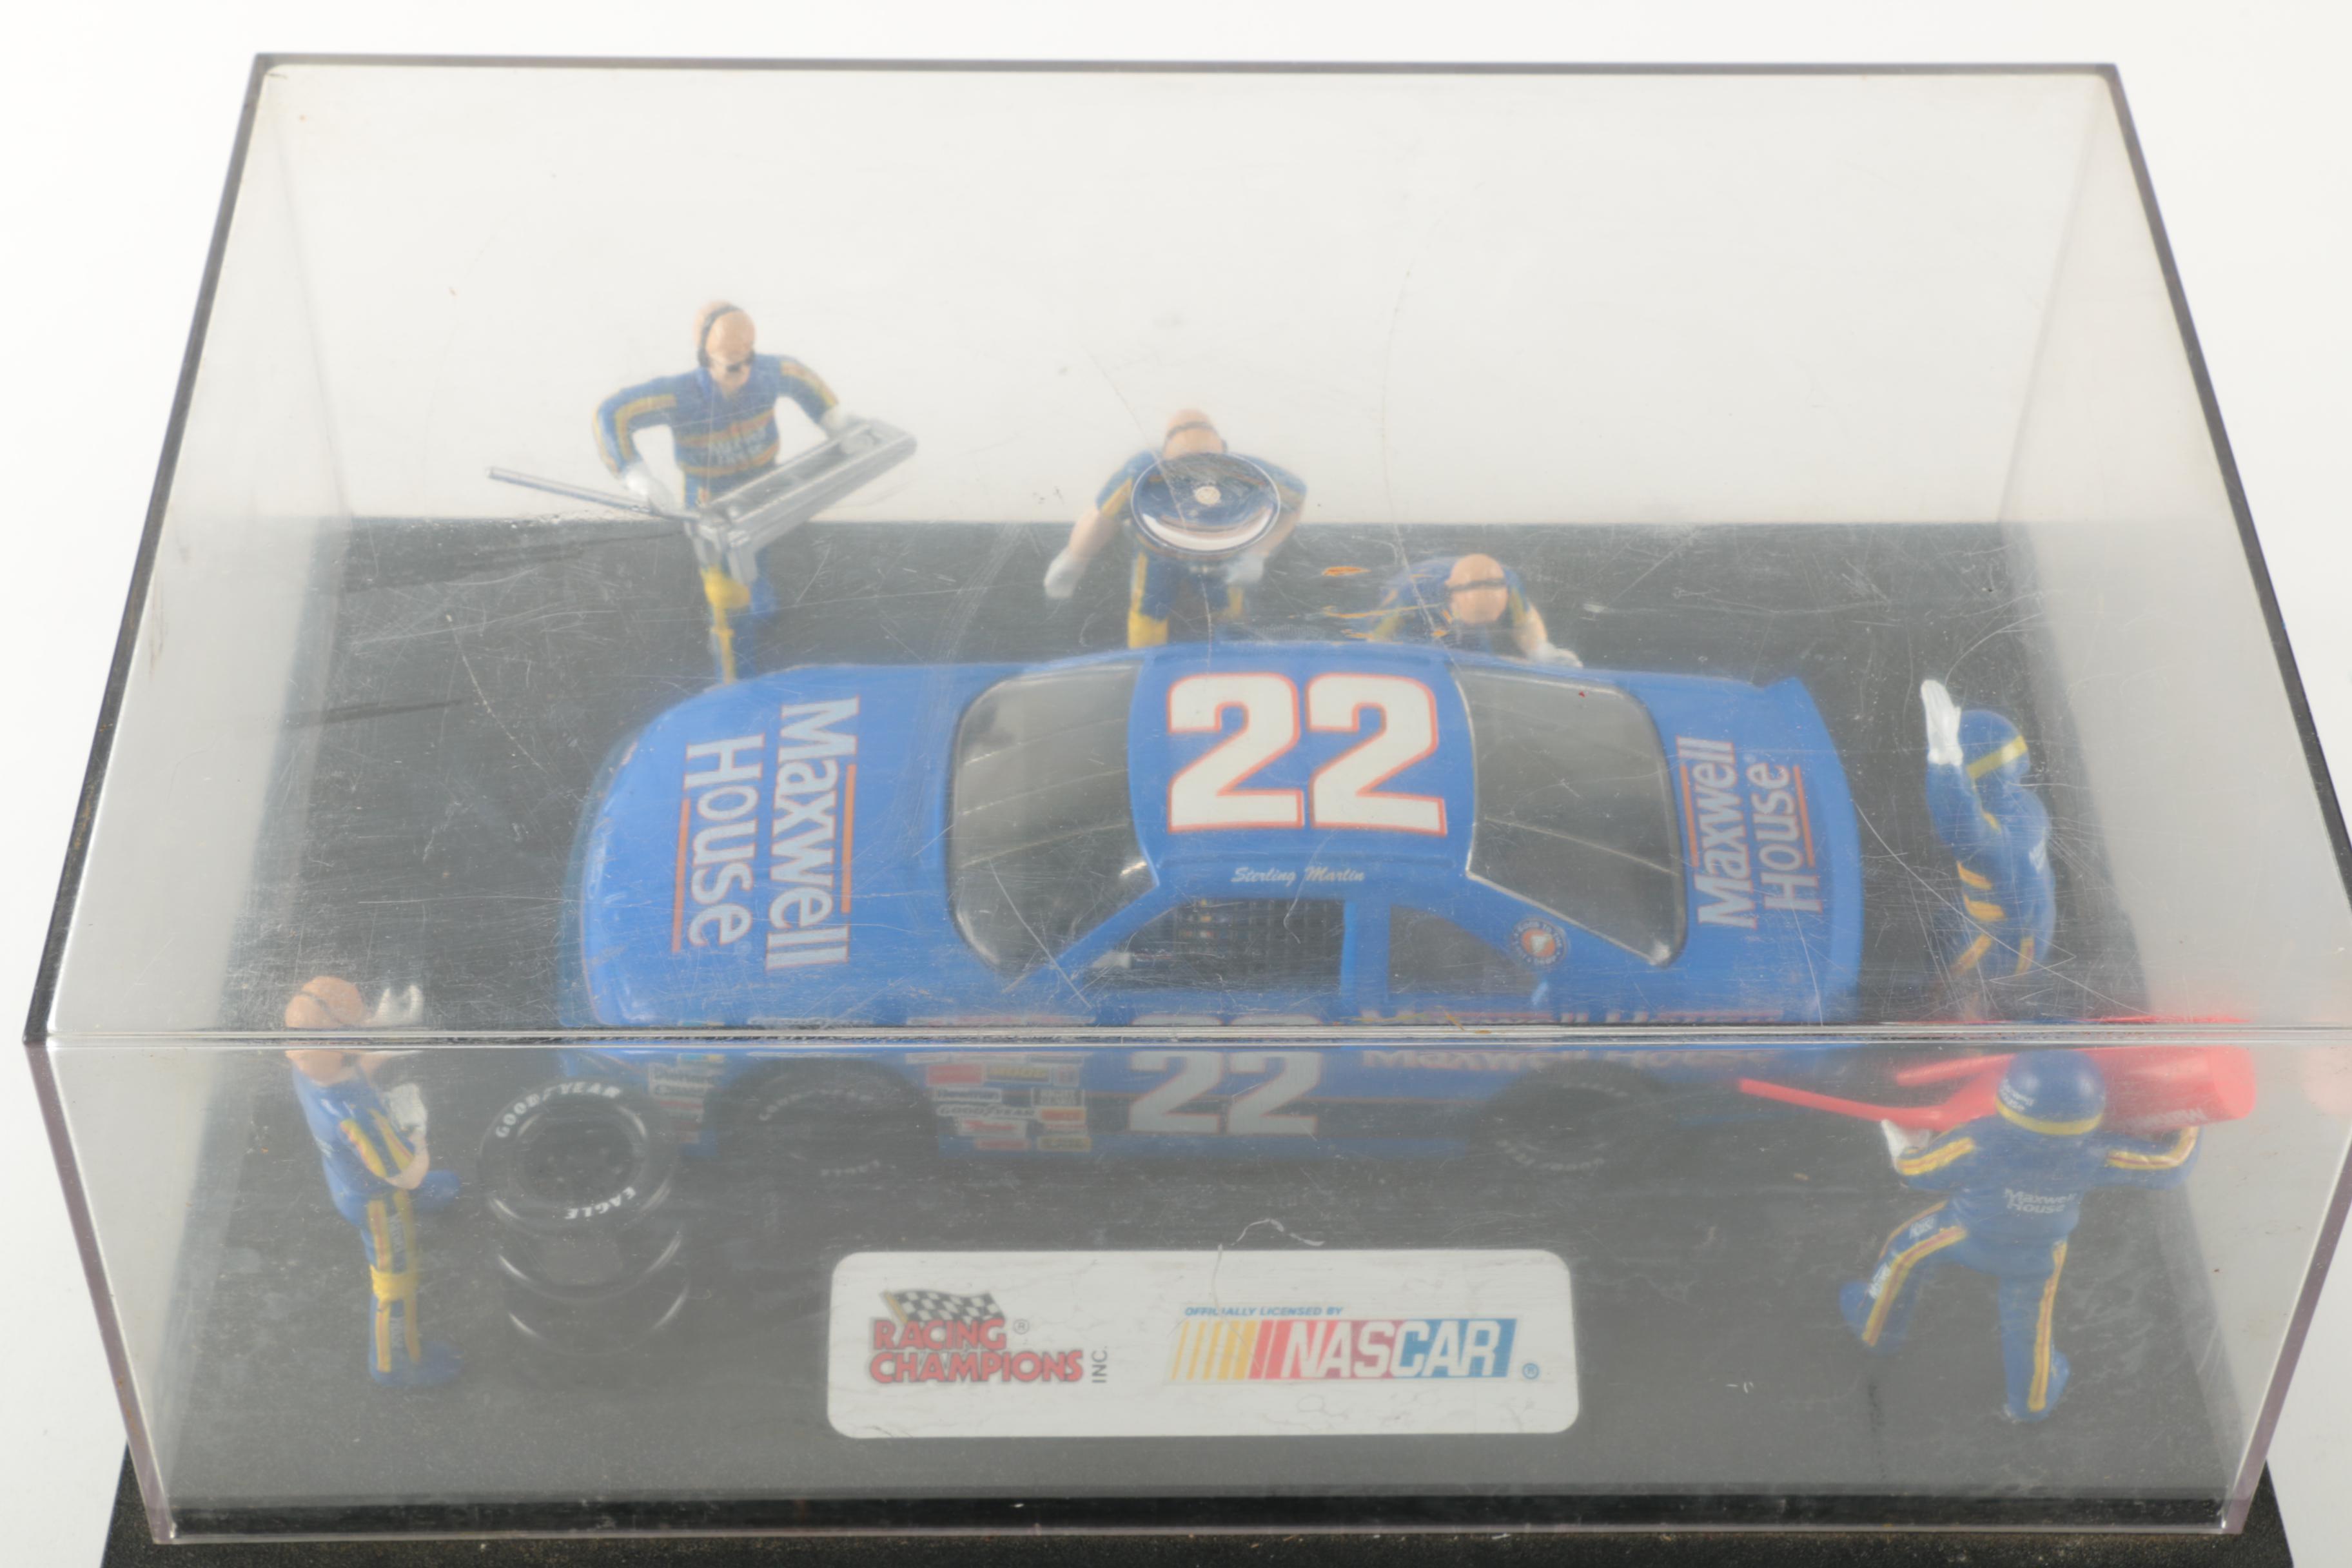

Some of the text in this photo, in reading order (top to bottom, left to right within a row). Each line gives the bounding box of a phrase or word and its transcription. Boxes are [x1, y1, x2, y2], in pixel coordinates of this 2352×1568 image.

[1166, 672, 1447, 836] 22
[682, 732, 766, 948] House
[765, 695, 860, 970] Maxwell
[1676, 736, 1758, 930] Maxwell
[1746, 761, 1822, 914] House
[495, 1081, 623, 1139] GOODYEAR
[1128, 1051, 1324, 1135] 22
[564, 1186, 637, 1221] EAGLE
[872, 1318, 1007, 1351] RACING
[1259, 1306, 1322, 1316] LICENSED
[1326, 1306, 1344, 1315] BY
[868, 1349, 1084, 1384] CHAMPIONS
[1091, 1345, 1108, 1384] INC.
[1281, 1319, 1501, 1378] NASCAR
